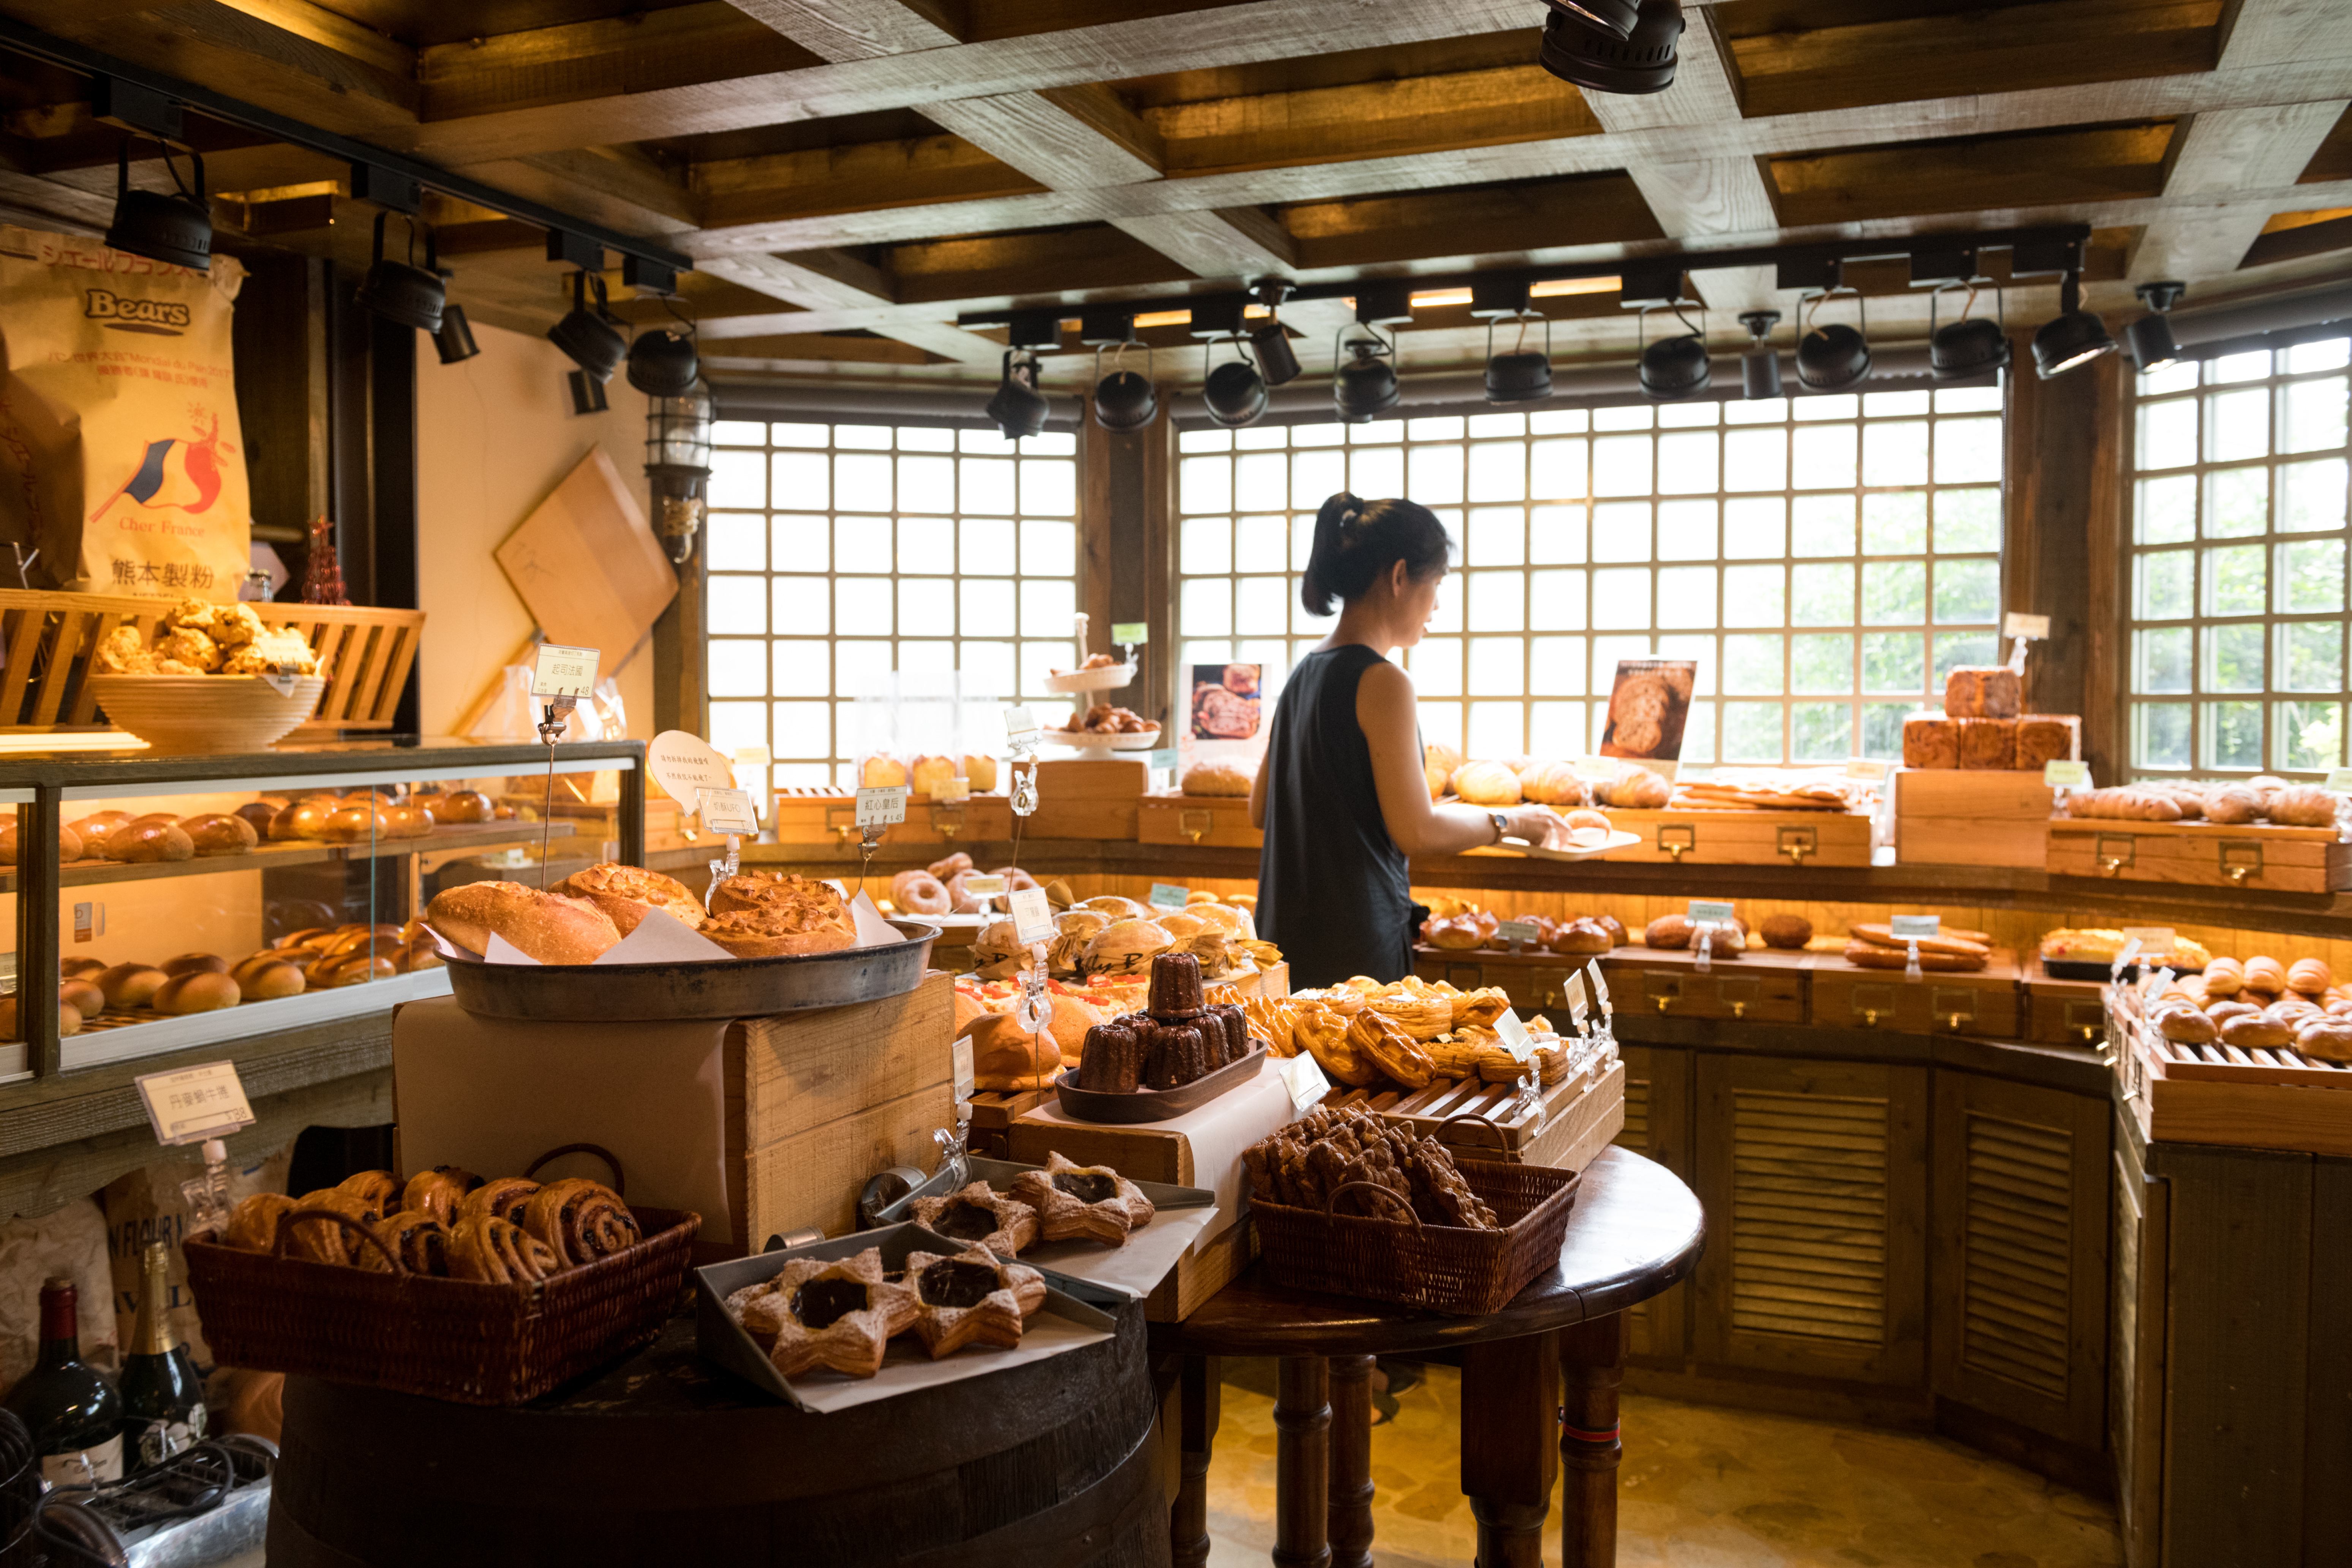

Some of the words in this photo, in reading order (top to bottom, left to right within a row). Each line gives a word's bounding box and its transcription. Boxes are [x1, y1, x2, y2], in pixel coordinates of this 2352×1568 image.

[84, 288, 190, 326] Bears
[119, 516, 155, 532] Cher
[161, 520, 205, 537] France
[112, 558, 214, 589] 熊本製粉
[552, 664, 583, 677] 起司法國
[580, 686, 589, 695] 48
[714, 801, 741, 812] 奶酥UFO
[865, 797, 899, 811] 紅心皇后
[745, 821, 753, 829] 38
[1024, 906, 1040, 918] 可麗露
[169, 1084, 229, 1110] 丹麥蝸牛捲
[233, 1107, 247, 1120] 38
